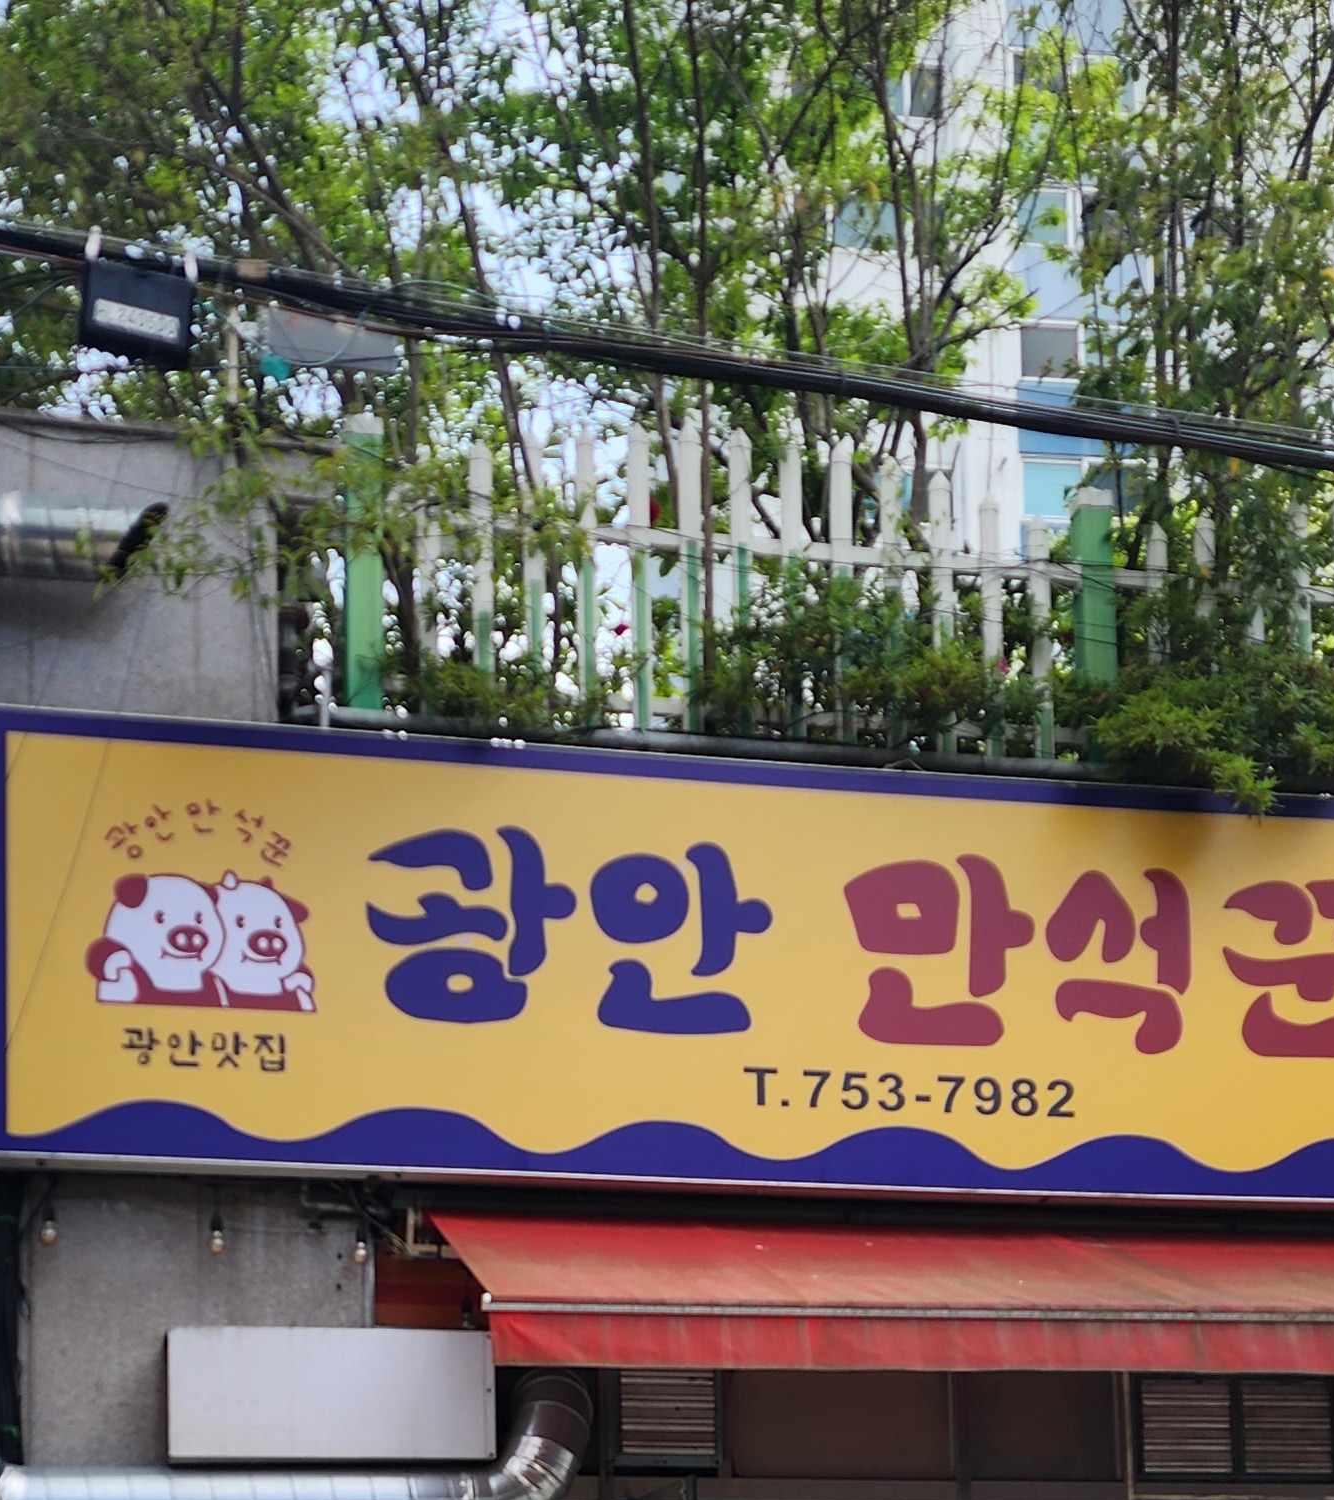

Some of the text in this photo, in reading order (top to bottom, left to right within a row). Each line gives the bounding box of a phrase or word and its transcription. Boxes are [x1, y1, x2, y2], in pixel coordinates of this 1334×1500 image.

[366, 825, 773, 1034] 광안
[121, 1027, 287, 1073] 광안맛집
[743, 1066, 1076, 1119] T.753-7982
